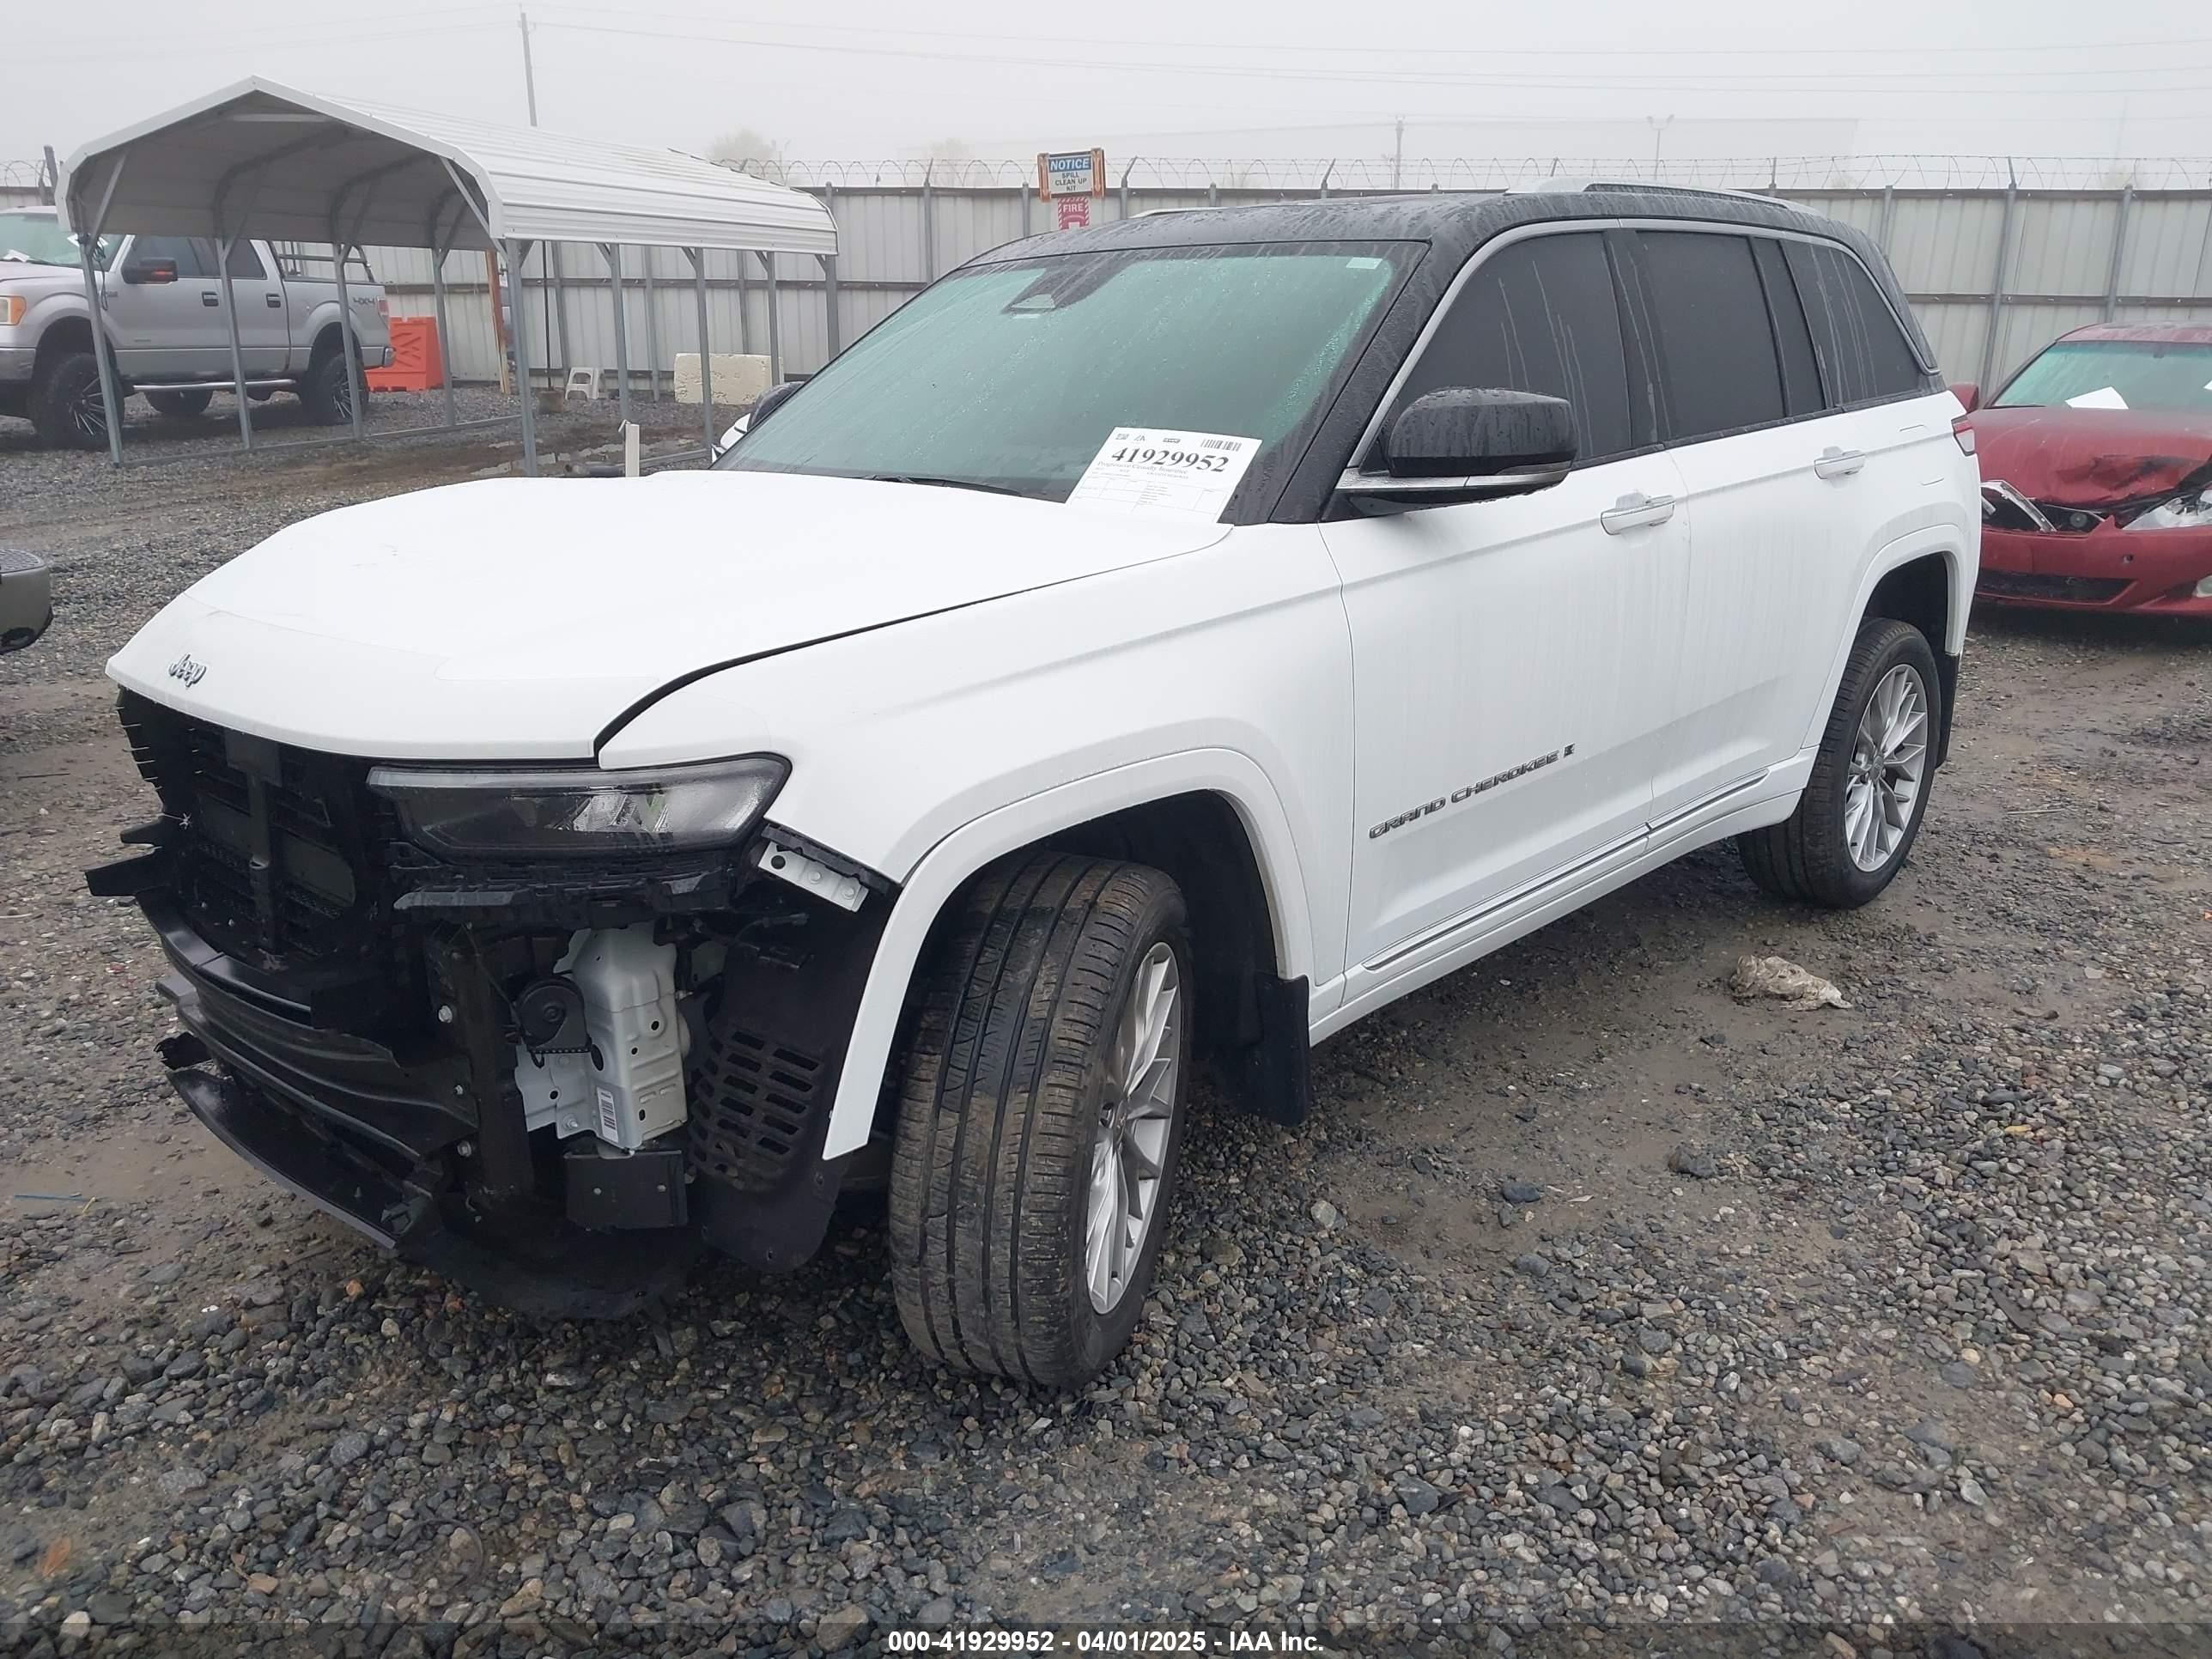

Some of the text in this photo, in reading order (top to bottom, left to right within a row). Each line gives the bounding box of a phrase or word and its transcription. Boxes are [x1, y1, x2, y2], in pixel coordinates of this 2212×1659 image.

[1050, 158, 1090, 171] NOTICE
[1062, 204, 1084, 212] FIRE
[1111, 447, 1230, 472] 41929952
[168, 653, 207, 688] Jeep
[1369, 750, 1559, 839] GRAND CHEROKEE
